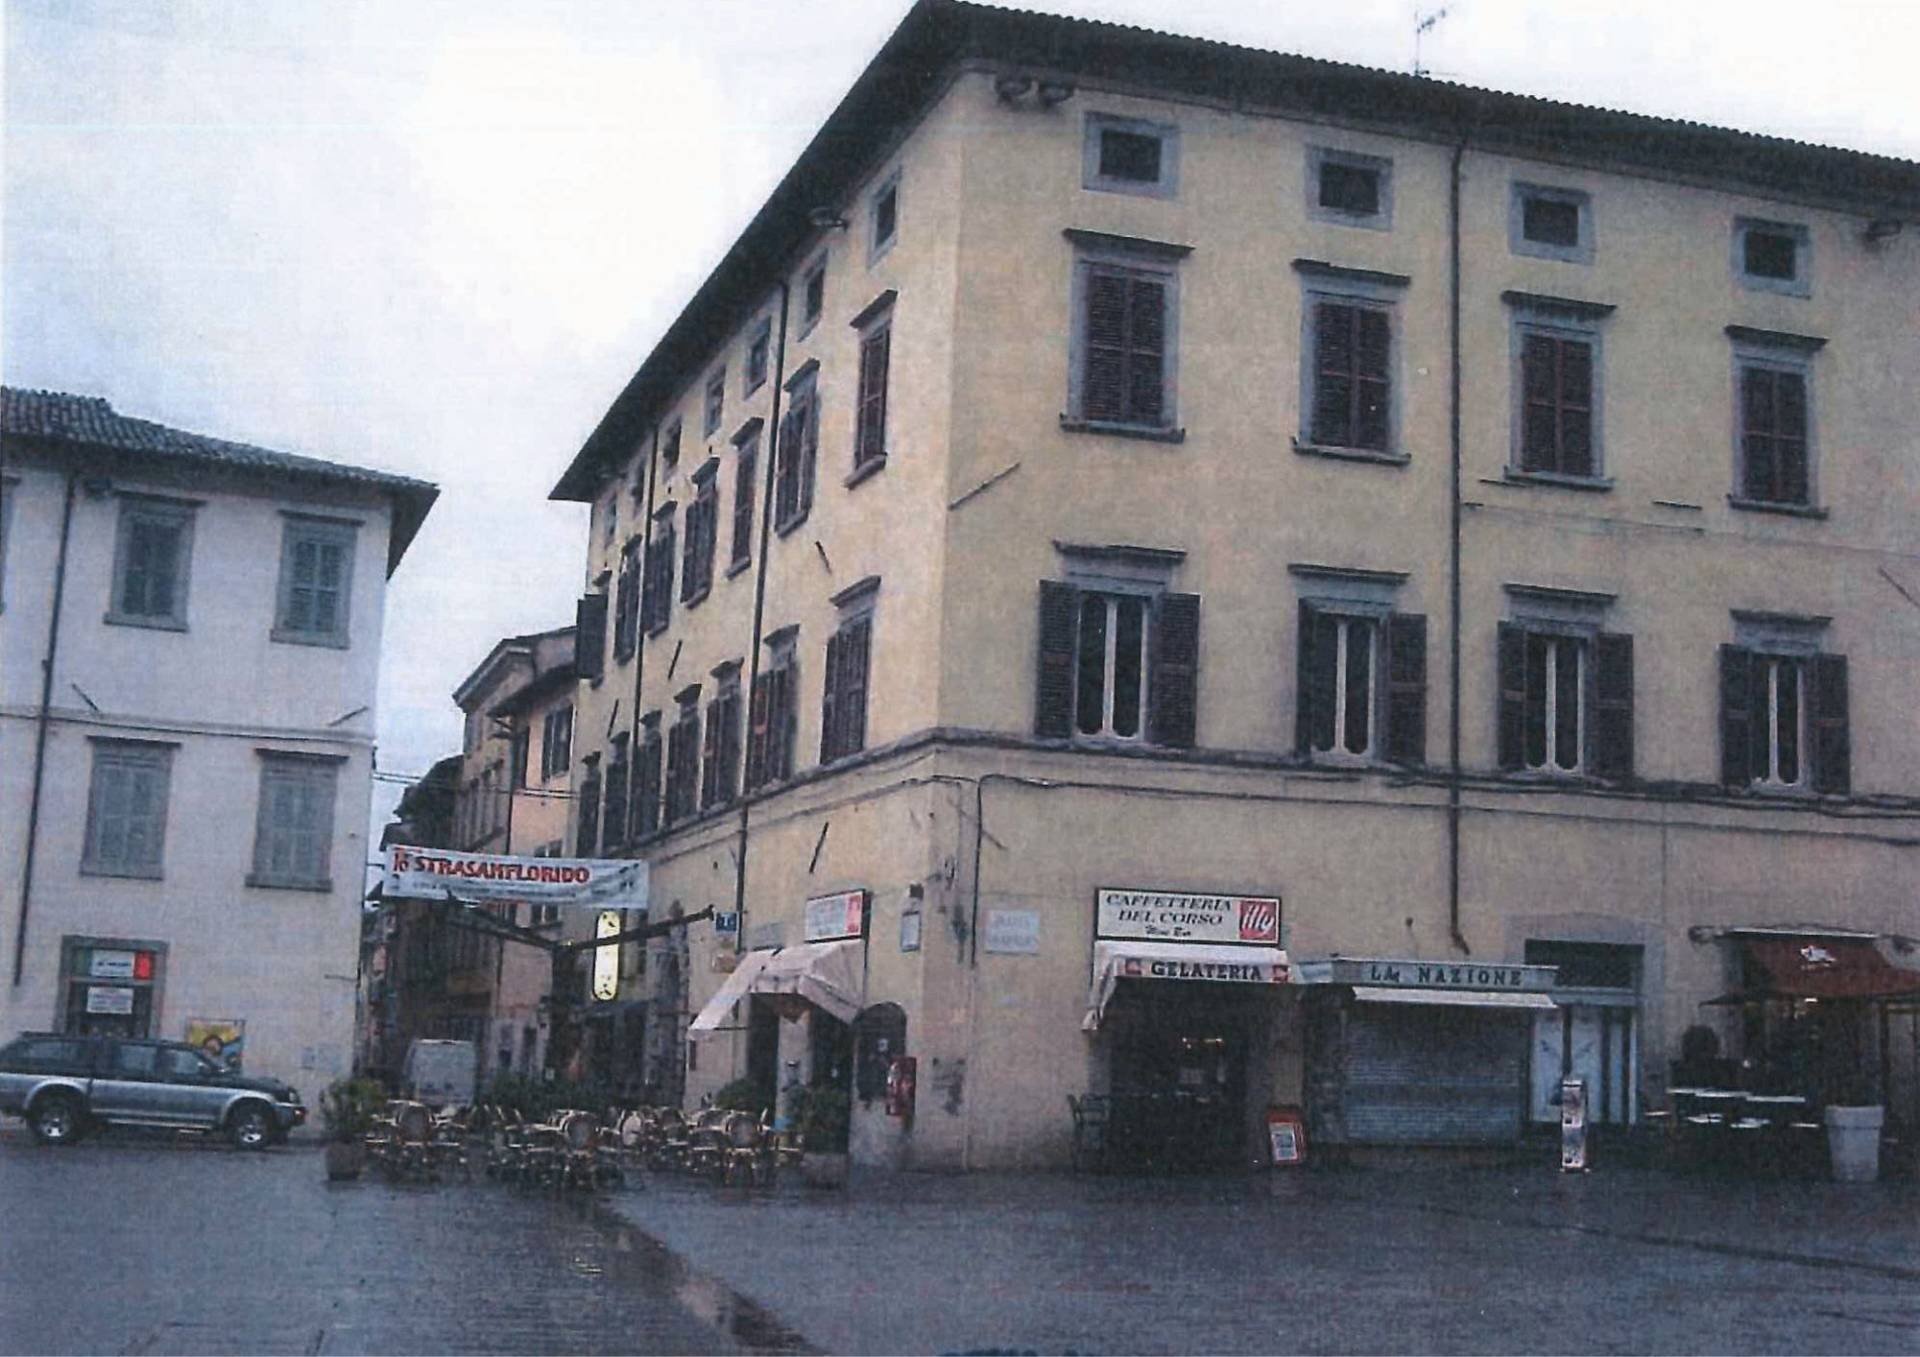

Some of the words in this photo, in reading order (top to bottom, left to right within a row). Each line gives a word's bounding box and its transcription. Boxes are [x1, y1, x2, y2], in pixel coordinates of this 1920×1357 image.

[1106, 894, 1232, 911] CAFFETTERIA
[1118, 909, 1155, 923] DEL
[1159, 912, 1223, 925] CORSO
[1241, 903, 1276, 936] illy
[1150, 960, 1263, 980] GELATERIA
[1418, 967, 1523, 985] NAZIONE
